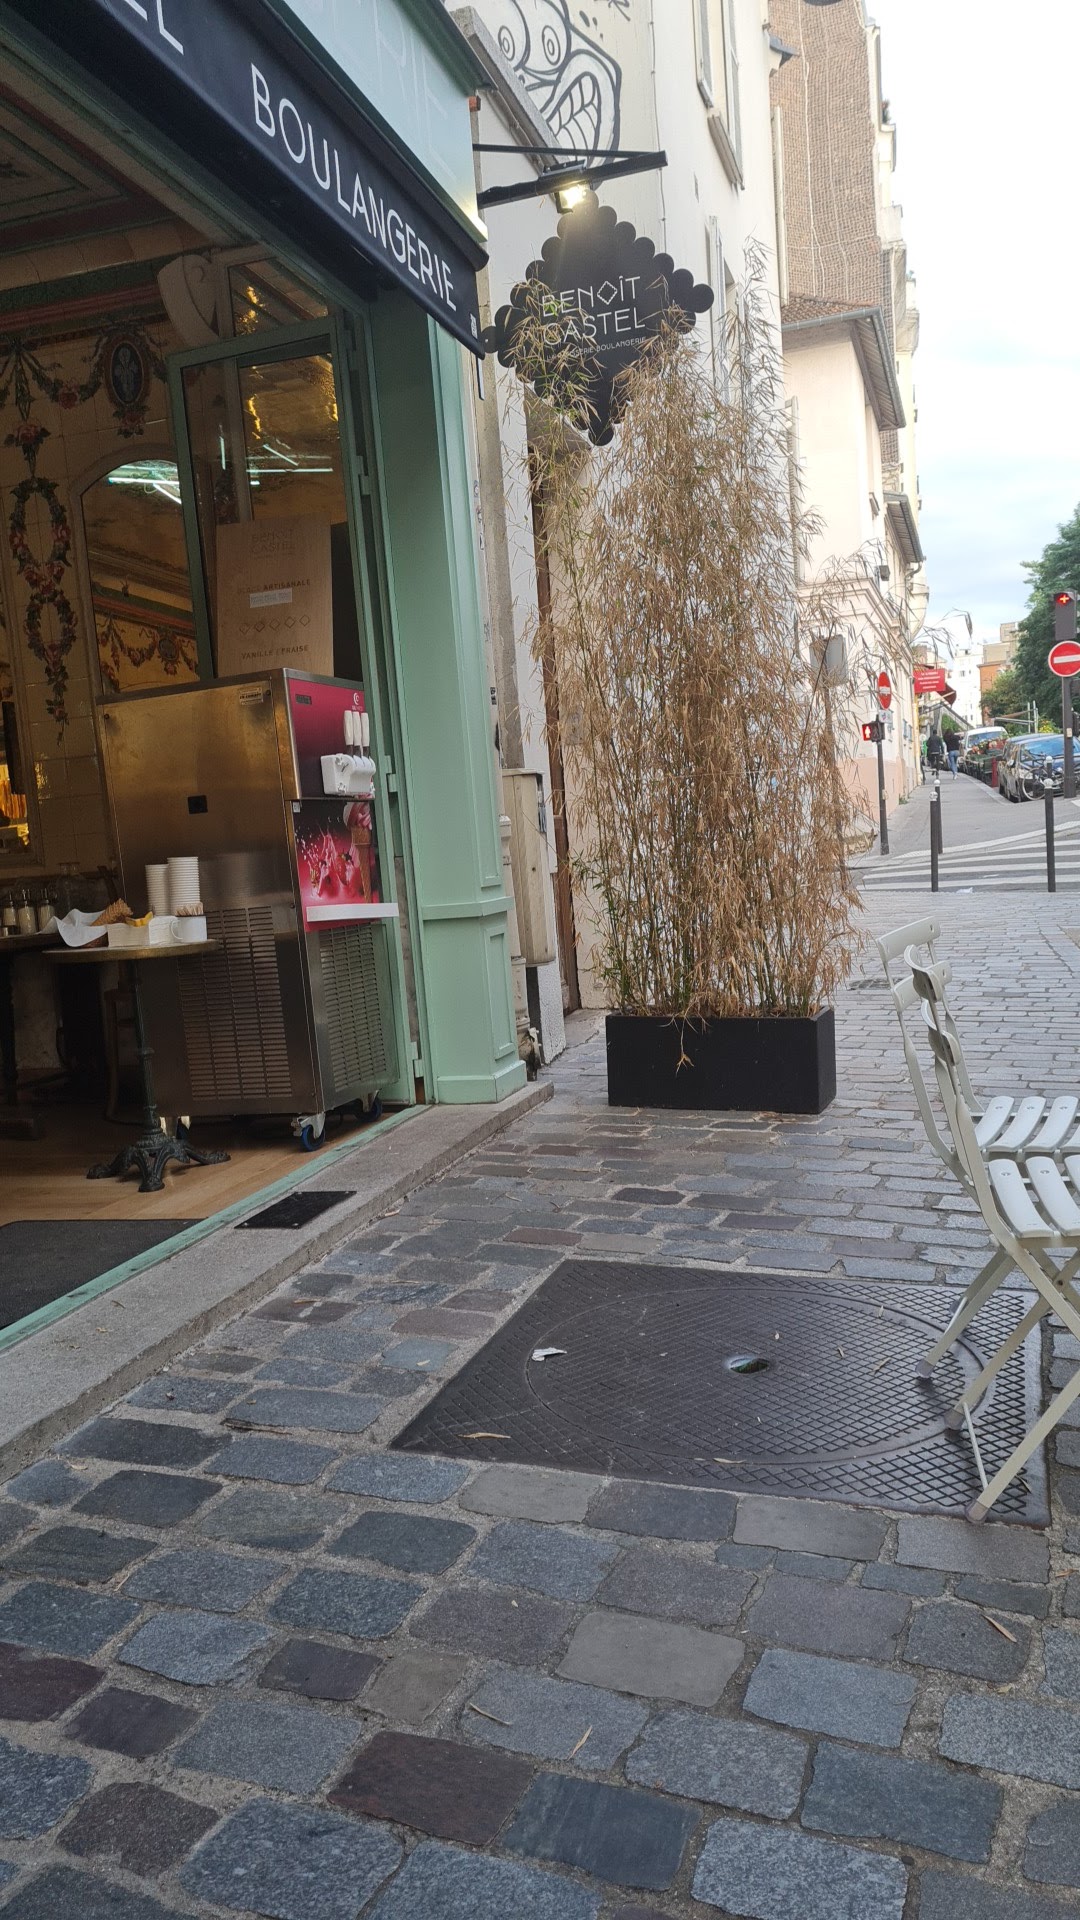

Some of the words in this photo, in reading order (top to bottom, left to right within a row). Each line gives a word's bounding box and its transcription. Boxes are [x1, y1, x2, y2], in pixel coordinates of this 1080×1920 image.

[251, 62, 457, 312] BOULANGERIE
[543, 307, 646, 345] CASTEL
[596, 336, 646, 353] BOULANGERIE
[263, 578, 311, 591] ARTISANALE
[241, 649, 273, 661] VANILLE
[281, 644, 309, 656] FRAISE
